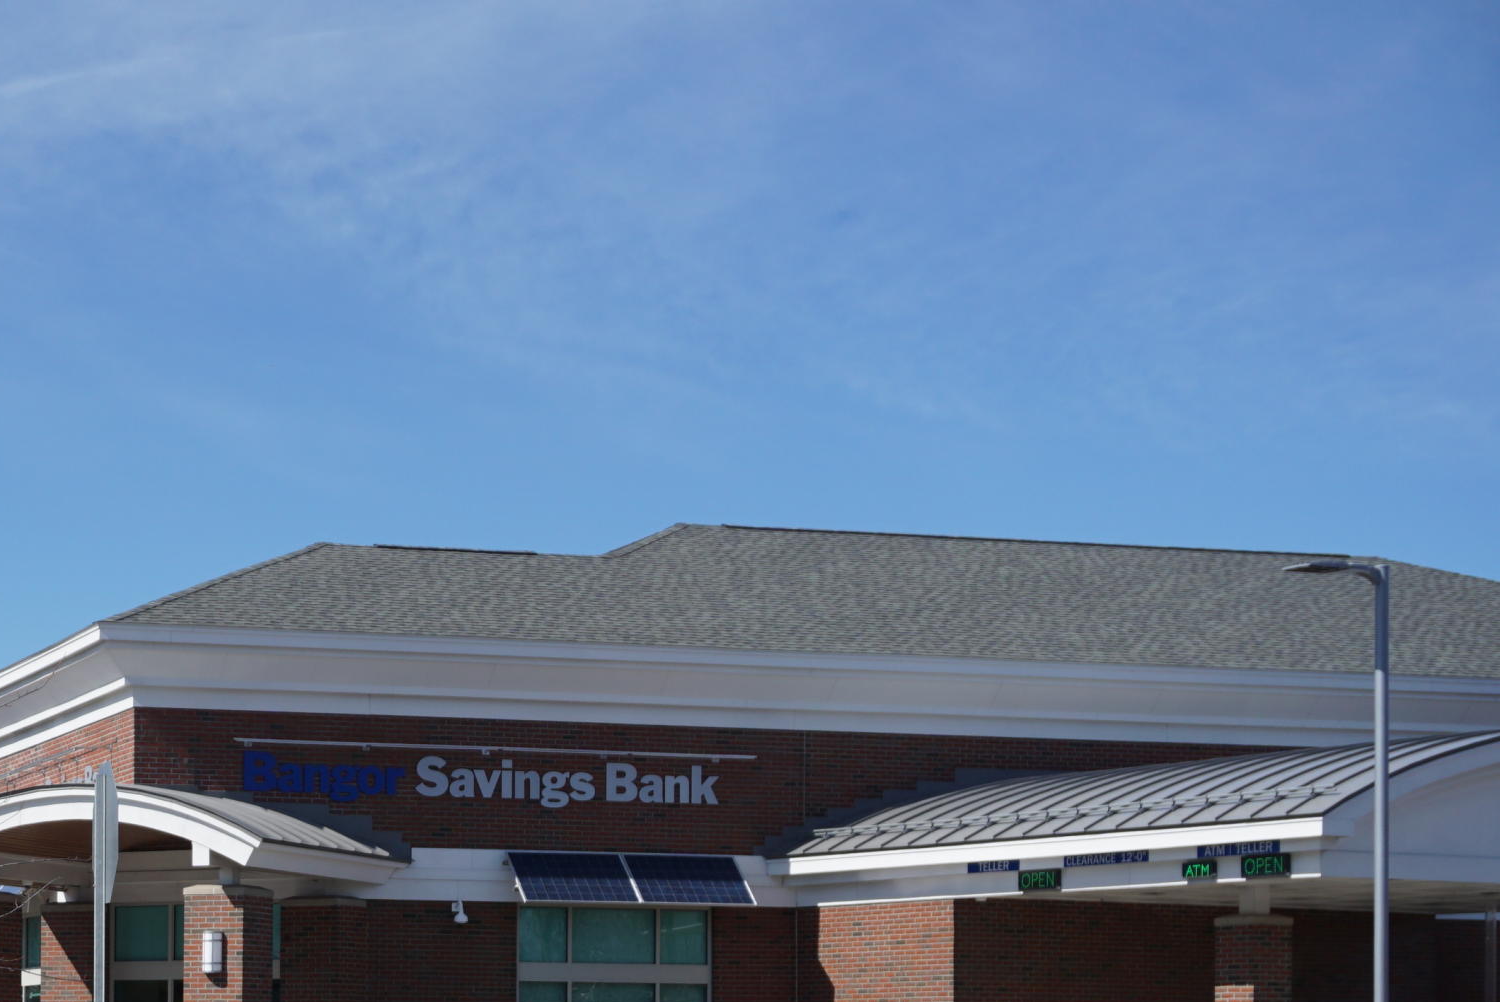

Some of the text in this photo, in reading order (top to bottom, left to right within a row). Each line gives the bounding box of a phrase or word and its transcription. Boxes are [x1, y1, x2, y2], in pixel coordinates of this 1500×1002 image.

[241, 750, 720, 808] Bangor Savings Bank
[1204, 841, 1273, 857] ATM TELLER
[978, 861, 1010, 872] TELLER
[1066, 853, 1116, 866] CLEARANCE
[1244, 856, 1284, 875] OPEN
[1185, 863, 1210, 878] ATM
[1021, 871, 1056, 889] OPEN
